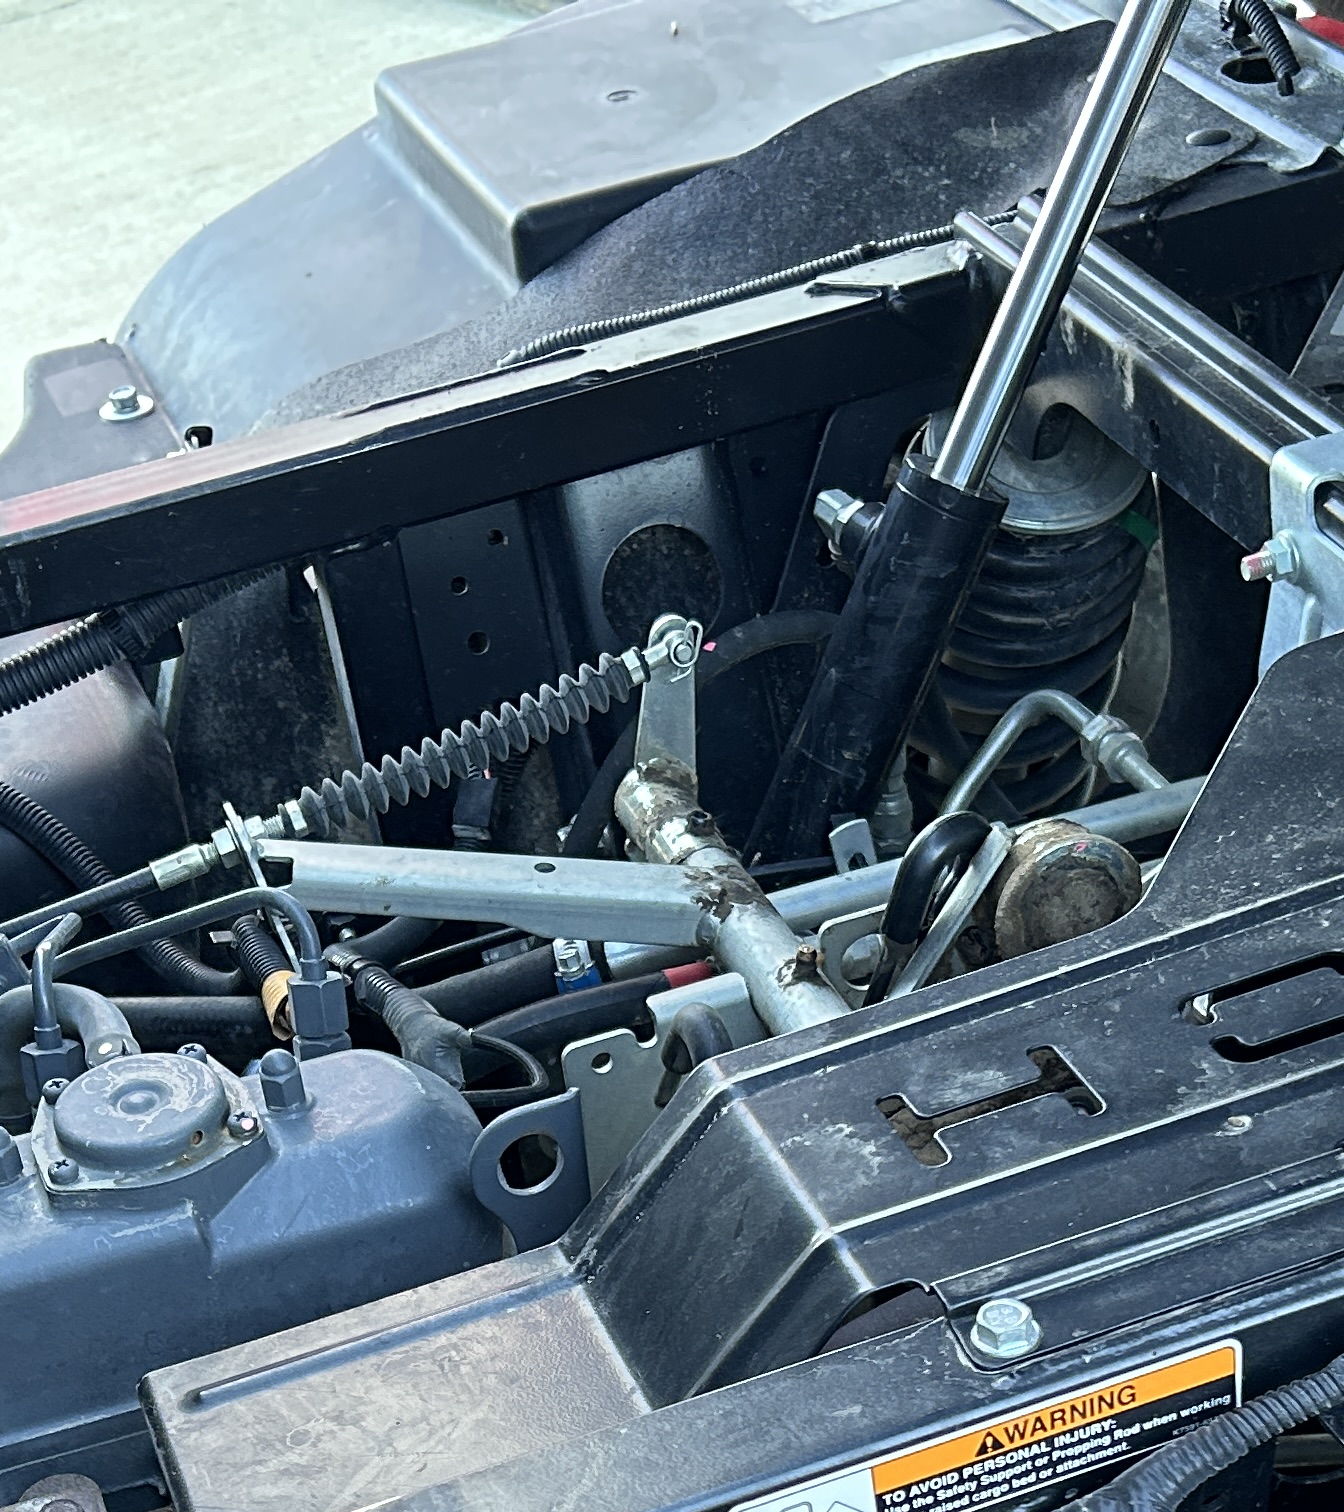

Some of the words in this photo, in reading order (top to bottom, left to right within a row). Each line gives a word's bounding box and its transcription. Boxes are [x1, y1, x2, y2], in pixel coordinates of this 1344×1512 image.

[1003, 1385, 1136, 1444] WARNING
[882, 1490, 906, 1505] TO
[909, 1472, 959, 1497] AVOID
[962, 1442, 1051, 1479] PERSONAL
[1054, 1419, 1117, 1447] INJURY:
[912, 1495, 934, 1509] the
[936, 1480, 977, 1501] Safety
[980, 1460, 1033, 1485] Support
[1034, 1455, 1050, 1467] or
[1052, 1435, 1111, 1461] Propping
[1113, 1423, 1141, 1440] Rod
[1142, 1413, 1177, 1430] when
[1180, 1395, 1231, 1417] working
[972, 1484, 1009, 1502] cargo
[1012, 1472, 1036, 1488] bed
[1039, 1468, 1054, 1479] or
[1056, 1442, 1131, 1473] attachment.
